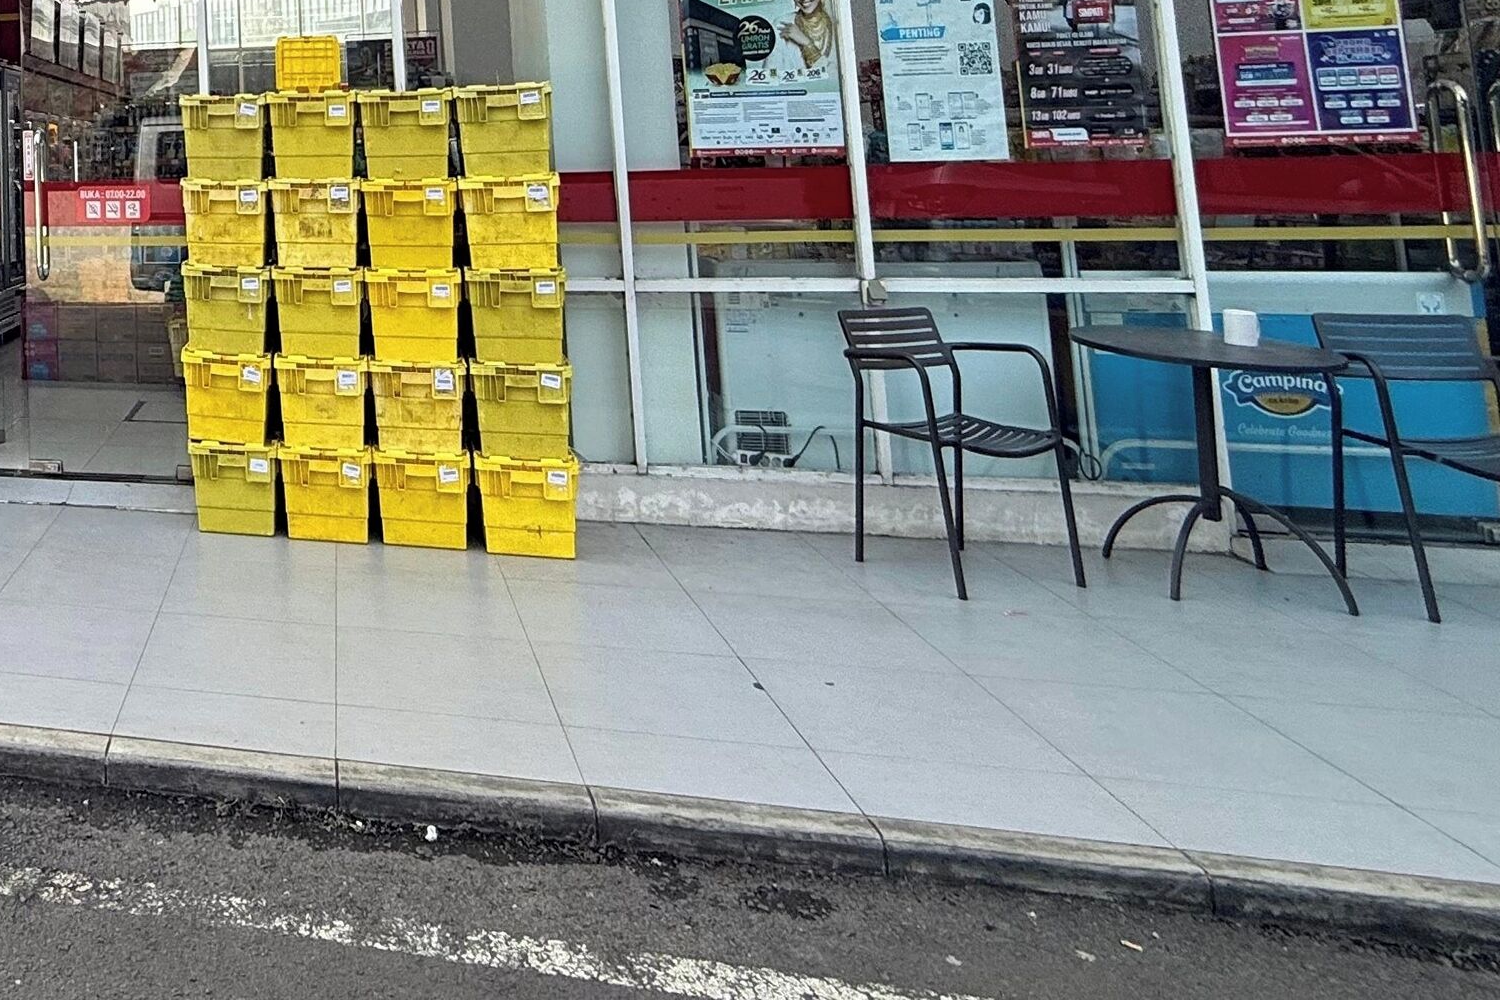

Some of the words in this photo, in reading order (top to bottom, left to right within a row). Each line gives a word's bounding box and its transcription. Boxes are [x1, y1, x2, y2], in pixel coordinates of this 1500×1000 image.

[1020, 10, 1047, 21] KAMU
[738, 20, 760, 38] 26
[899, 26, 941, 39] PENTING
[1021, 21, 1051, 33] KAMU!
[740, 34, 771, 43] UMROH
[741, 42, 770, 50] GRATIS
[80, 189, 101, 199] BUKA
[1238, 422, 1285, 437] Celebrate
